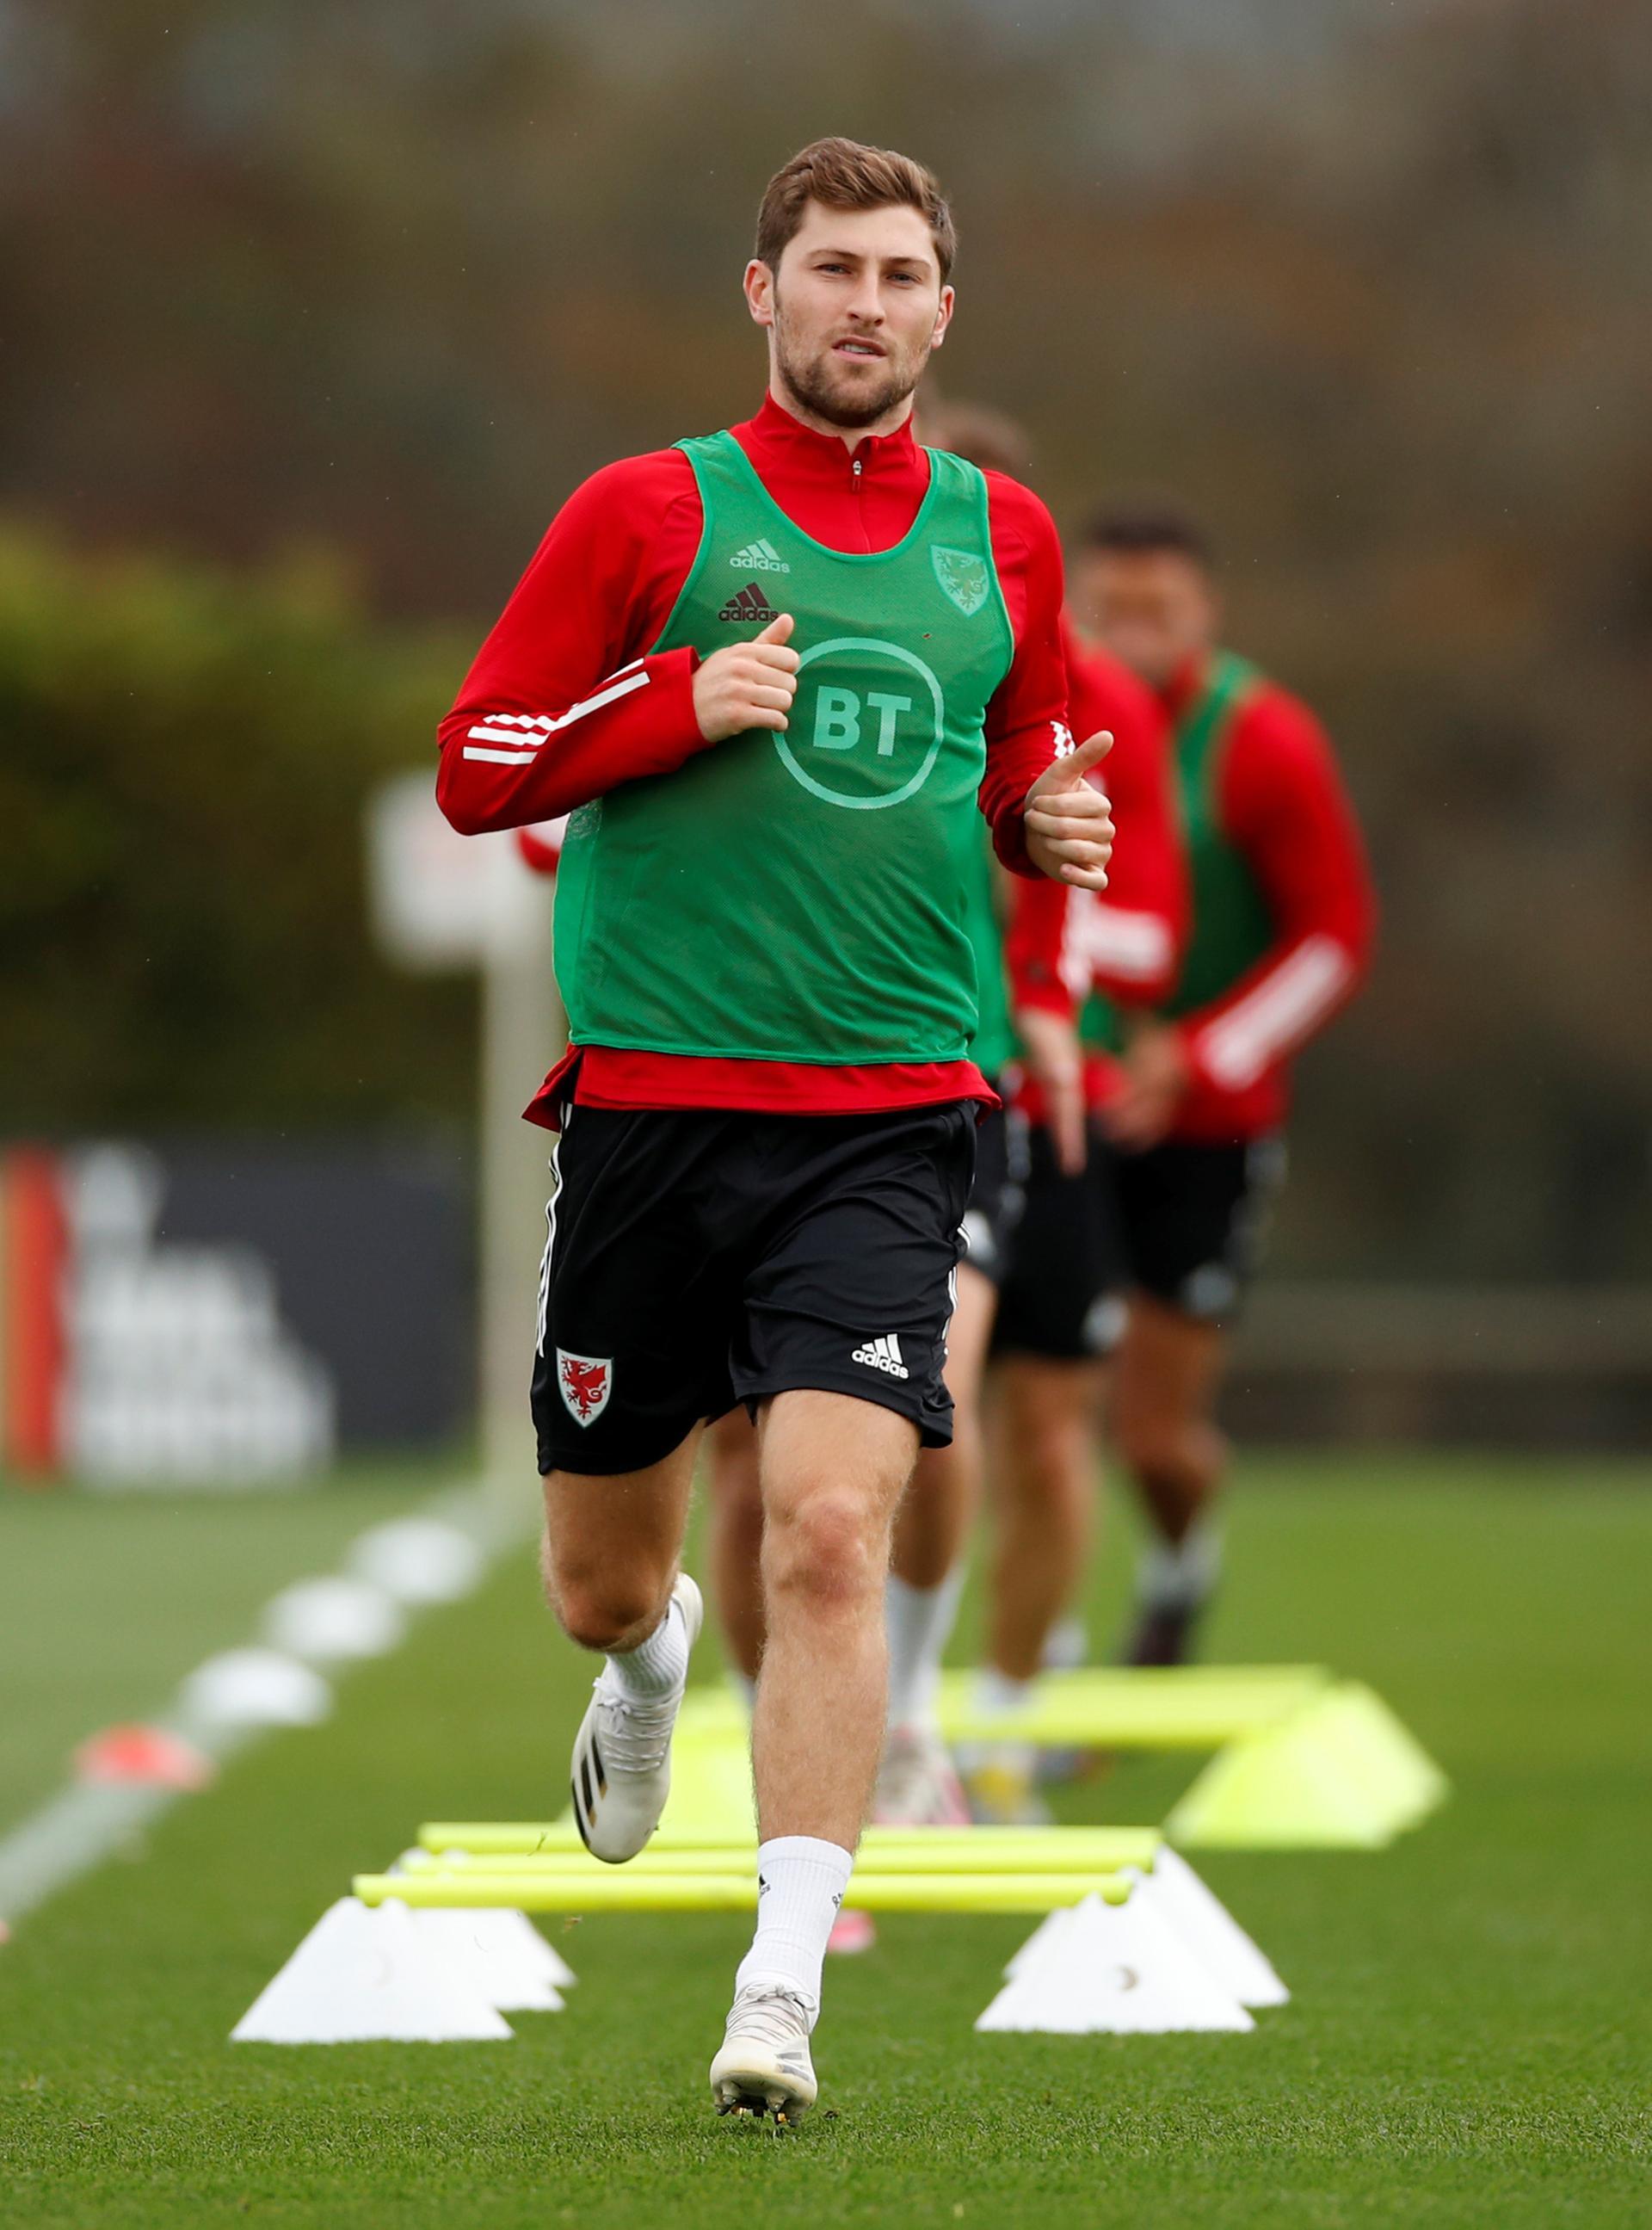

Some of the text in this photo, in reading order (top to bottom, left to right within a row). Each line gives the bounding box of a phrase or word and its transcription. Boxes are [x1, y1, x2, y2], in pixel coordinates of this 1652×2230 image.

[730, 556, 791, 573] adidas
[813, 685, 912, 757] BT
[851, 1349, 909, 1380] adidas
